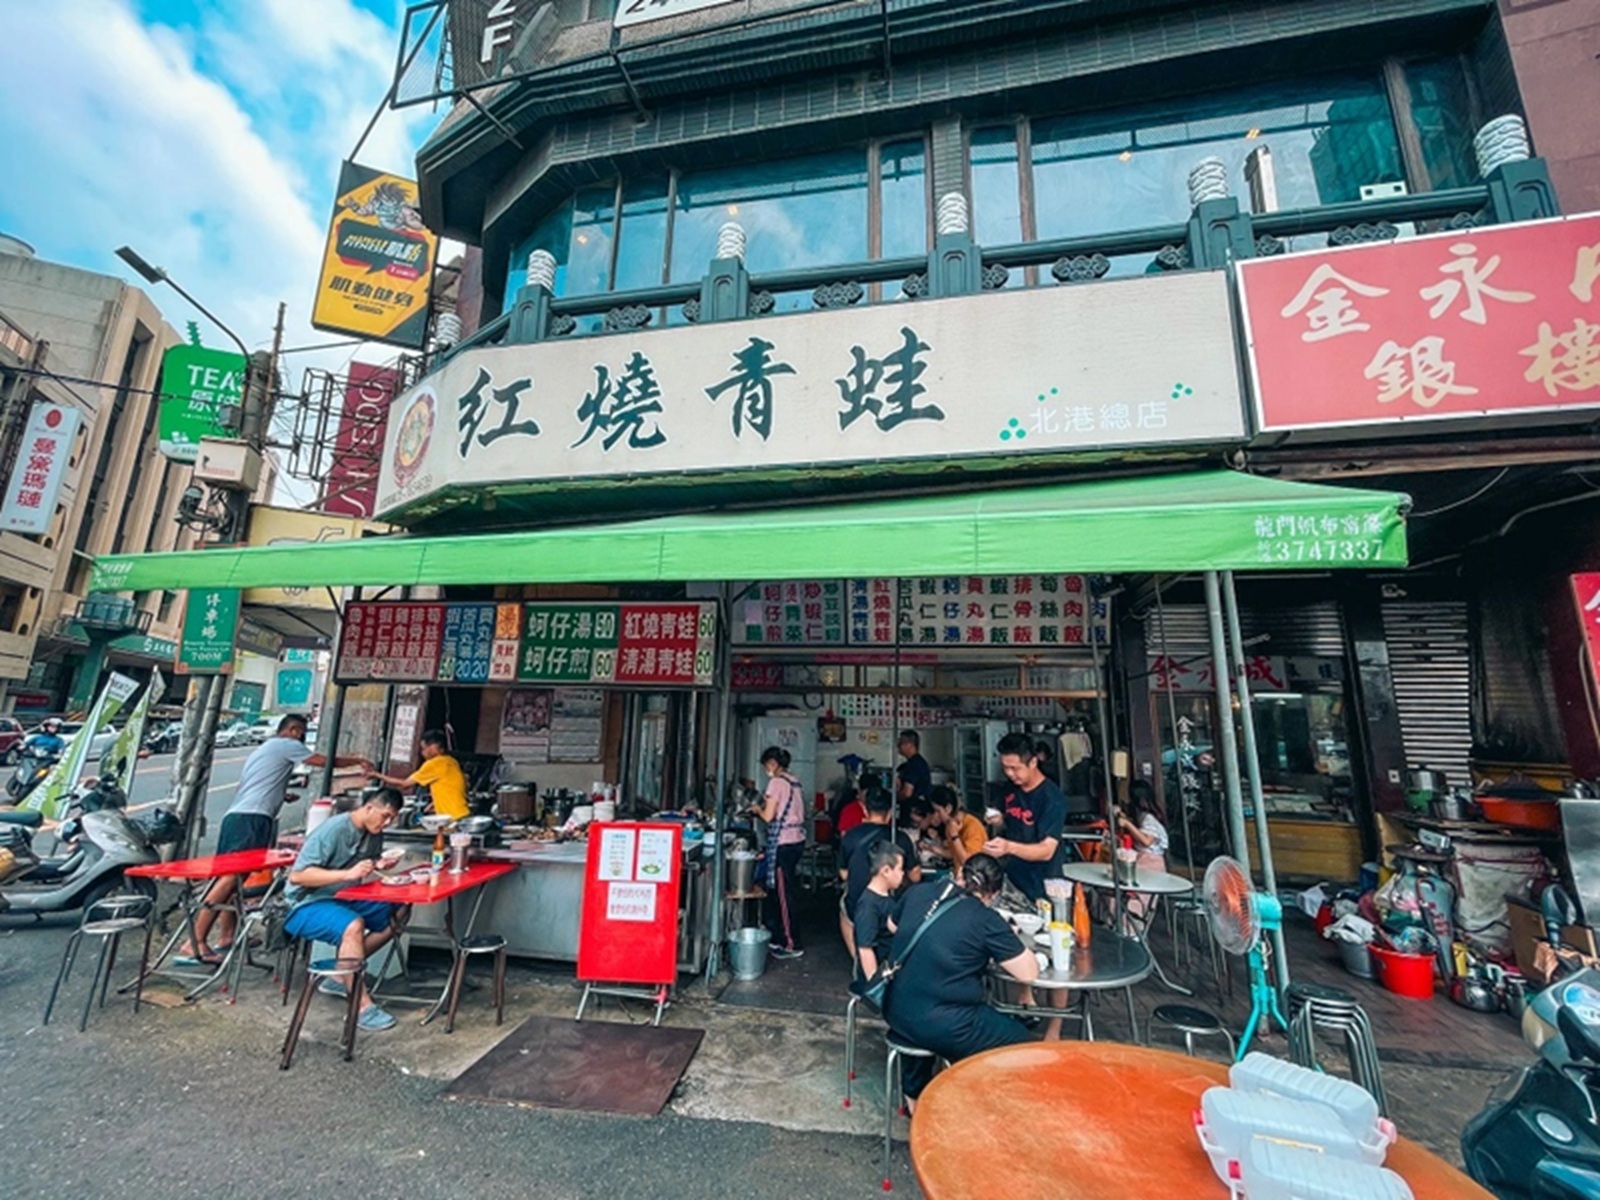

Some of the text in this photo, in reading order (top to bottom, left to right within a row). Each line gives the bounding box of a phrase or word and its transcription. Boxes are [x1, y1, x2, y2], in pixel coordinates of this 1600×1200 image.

[1281, 242, 1600, 343] 金永
[1030, 401, 1168, 434] 北港總店
[339, 381, 386, 518] SHEIDO
[1276, 540, 1383, 561] 3747337
[527, 612, 592, 639] 蚵仔湯
[872, 578, 891, 642] 紅燒青蛙
[966, 577, 985, 642] 貢丸湯
[1014, 576, 1033, 643] 排骨飯
[1039, 576, 1058, 643] 筍絲飯
[1063, 575, 1083, 643] 魯肉飯
[625, 612, 715, 640] 紅燒青蛙 60
[456, 662, 471, 677] 20
[471, 662, 488, 677] 20
[524, 647, 612, 676] 蚵仔煎 60
[621, 648, 712, 676] 清湯青蛙 60
